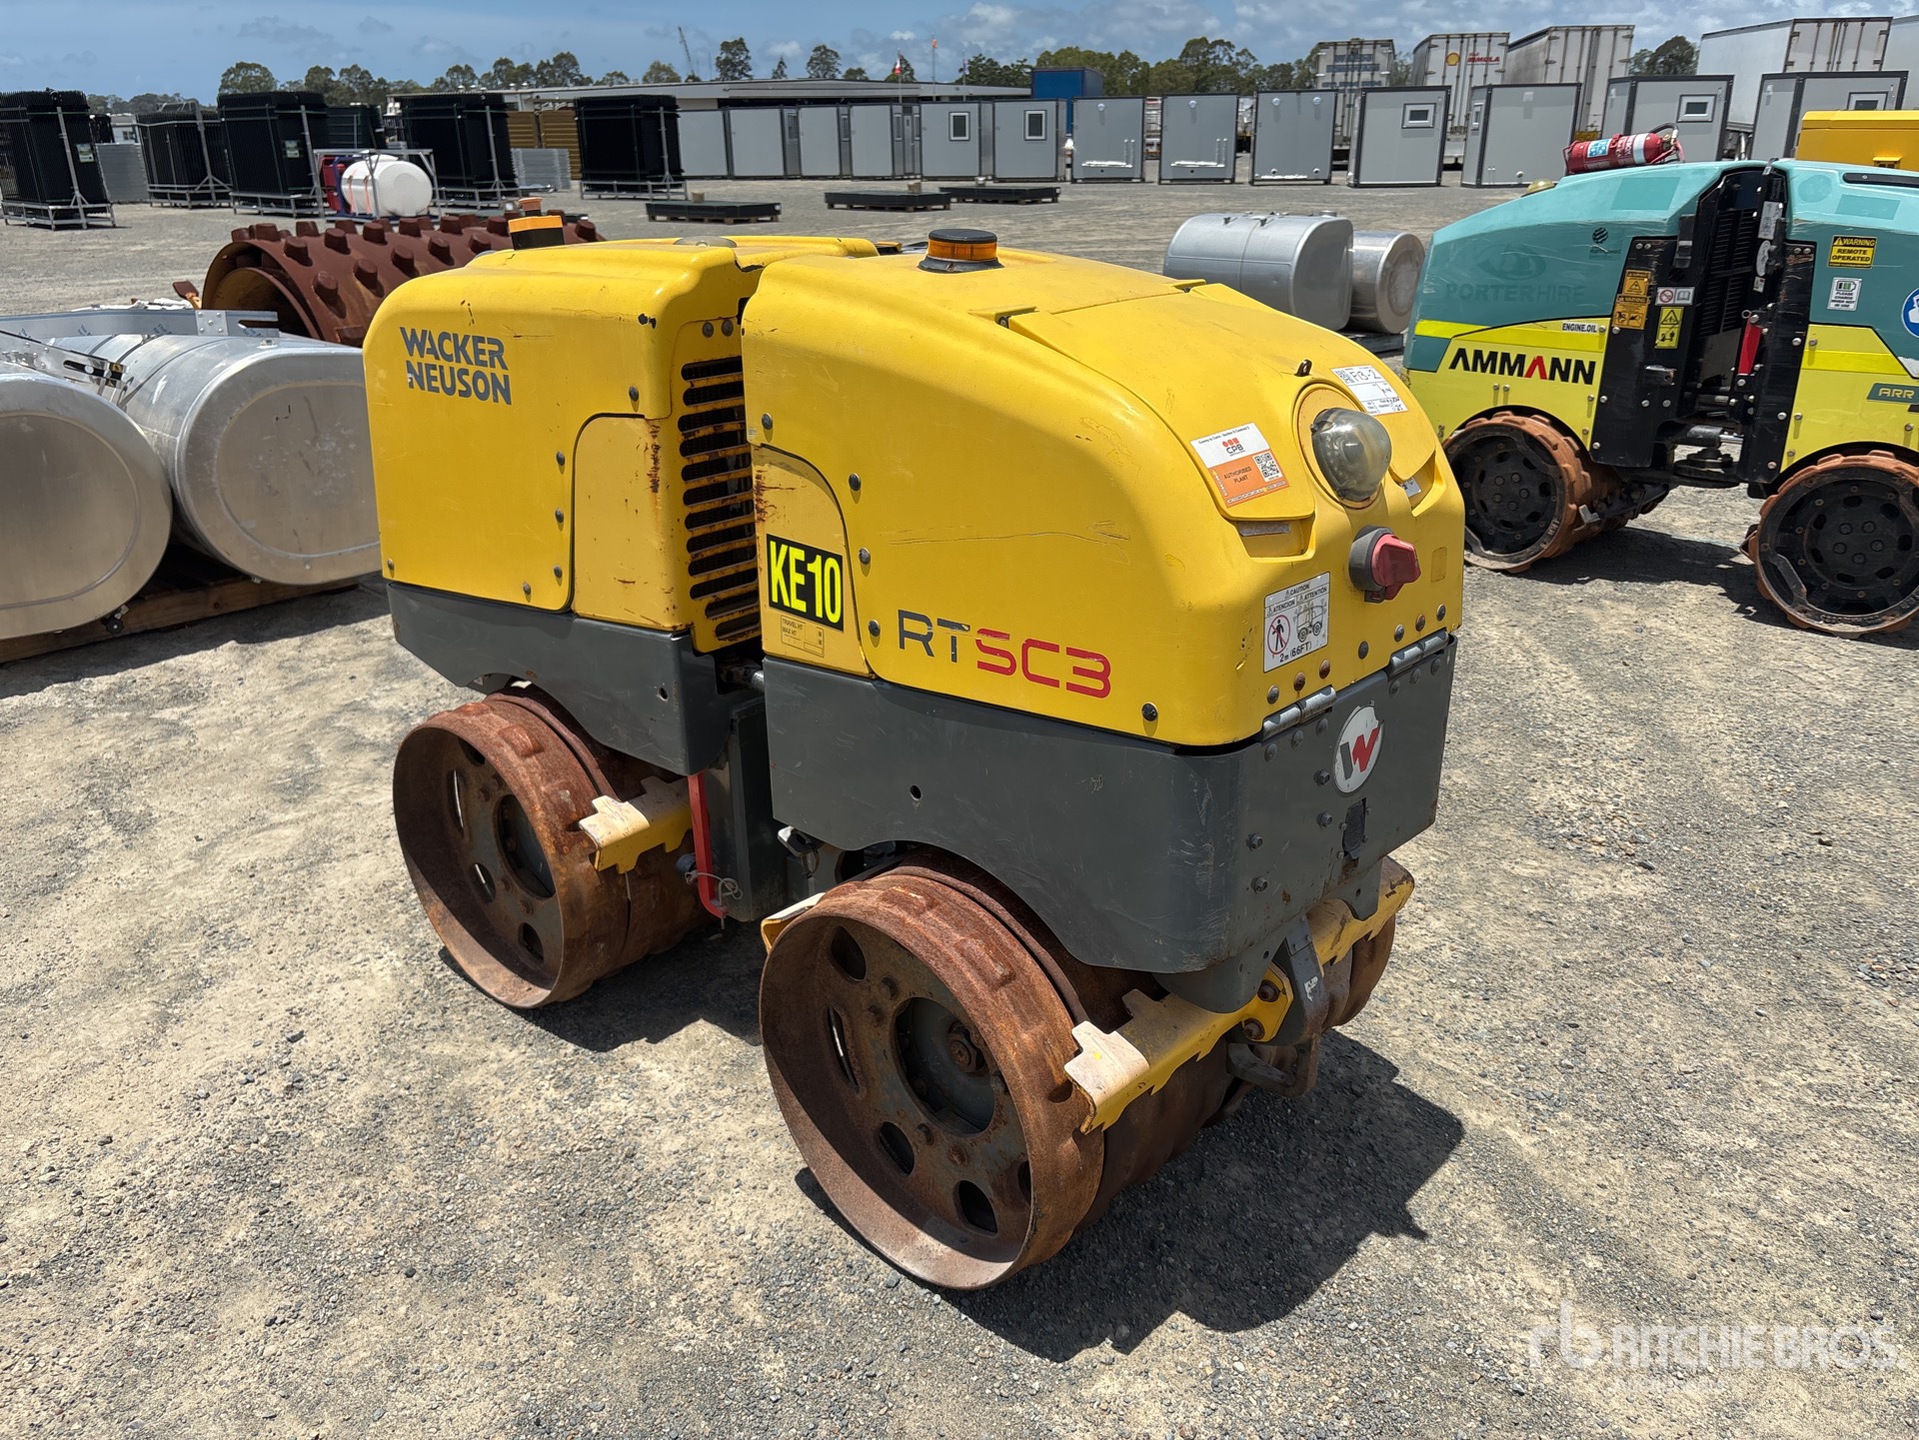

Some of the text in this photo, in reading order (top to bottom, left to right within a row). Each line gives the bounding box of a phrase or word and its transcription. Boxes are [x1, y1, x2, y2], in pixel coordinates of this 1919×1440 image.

[1843, 238, 1876, 246] WARNING
[400, 326, 509, 371] WACKER
[1448, 347, 1596, 385] AMMANN
[406, 360, 512, 406] NEUSON
[1878, 387, 1915, 399] ARR
[1226, 443, 1244, 454] CPB
[1223, 466, 1252, 479] AUTHORISED
[1233, 475, 1249, 484] PLANT
[1290, 583, 1310, 596] CAUTION
